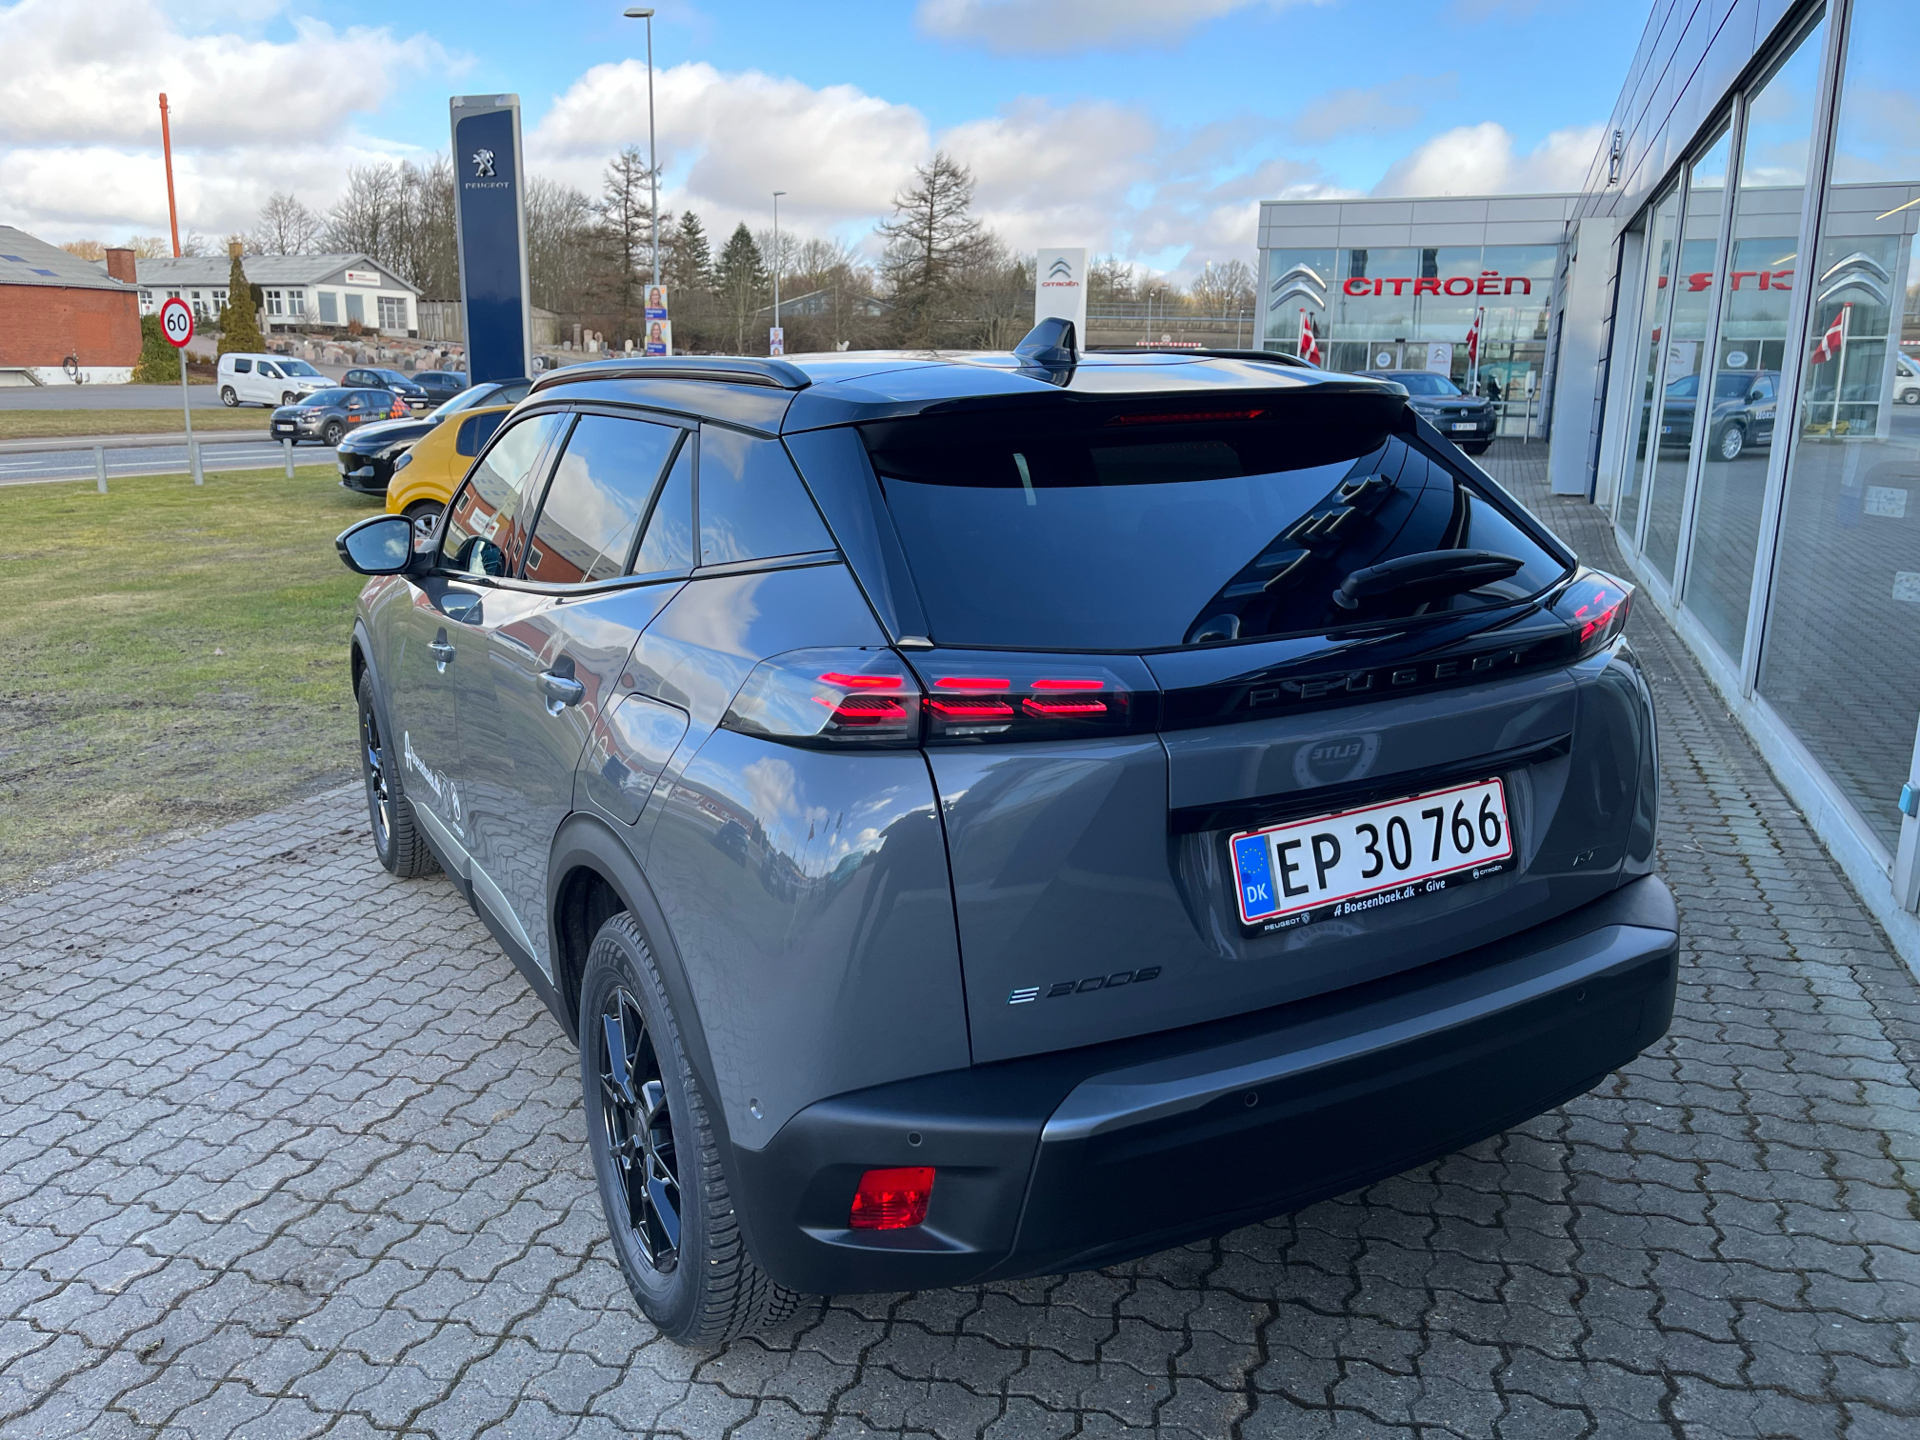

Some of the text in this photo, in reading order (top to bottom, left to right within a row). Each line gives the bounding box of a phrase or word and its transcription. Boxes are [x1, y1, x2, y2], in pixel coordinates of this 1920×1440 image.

[465, 182, 510, 190] PEUGEOT
[1342, 270, 1532, 296] CITROËN
[167, 313, 187, 332] 60
[1250, 650, 1526, 707] PEUGEOT
[1276, 793, 1502, 898] EP 30 766
[1246, 883, 1268, 904] DK
[1344, 886, 1416, 914] Boesenbaek.dk
[1426, 879, 1446, 892] Give
[1264, 917, 1300, 931] PEUGEOT
[1046, 965, 1162, 998] 2008
